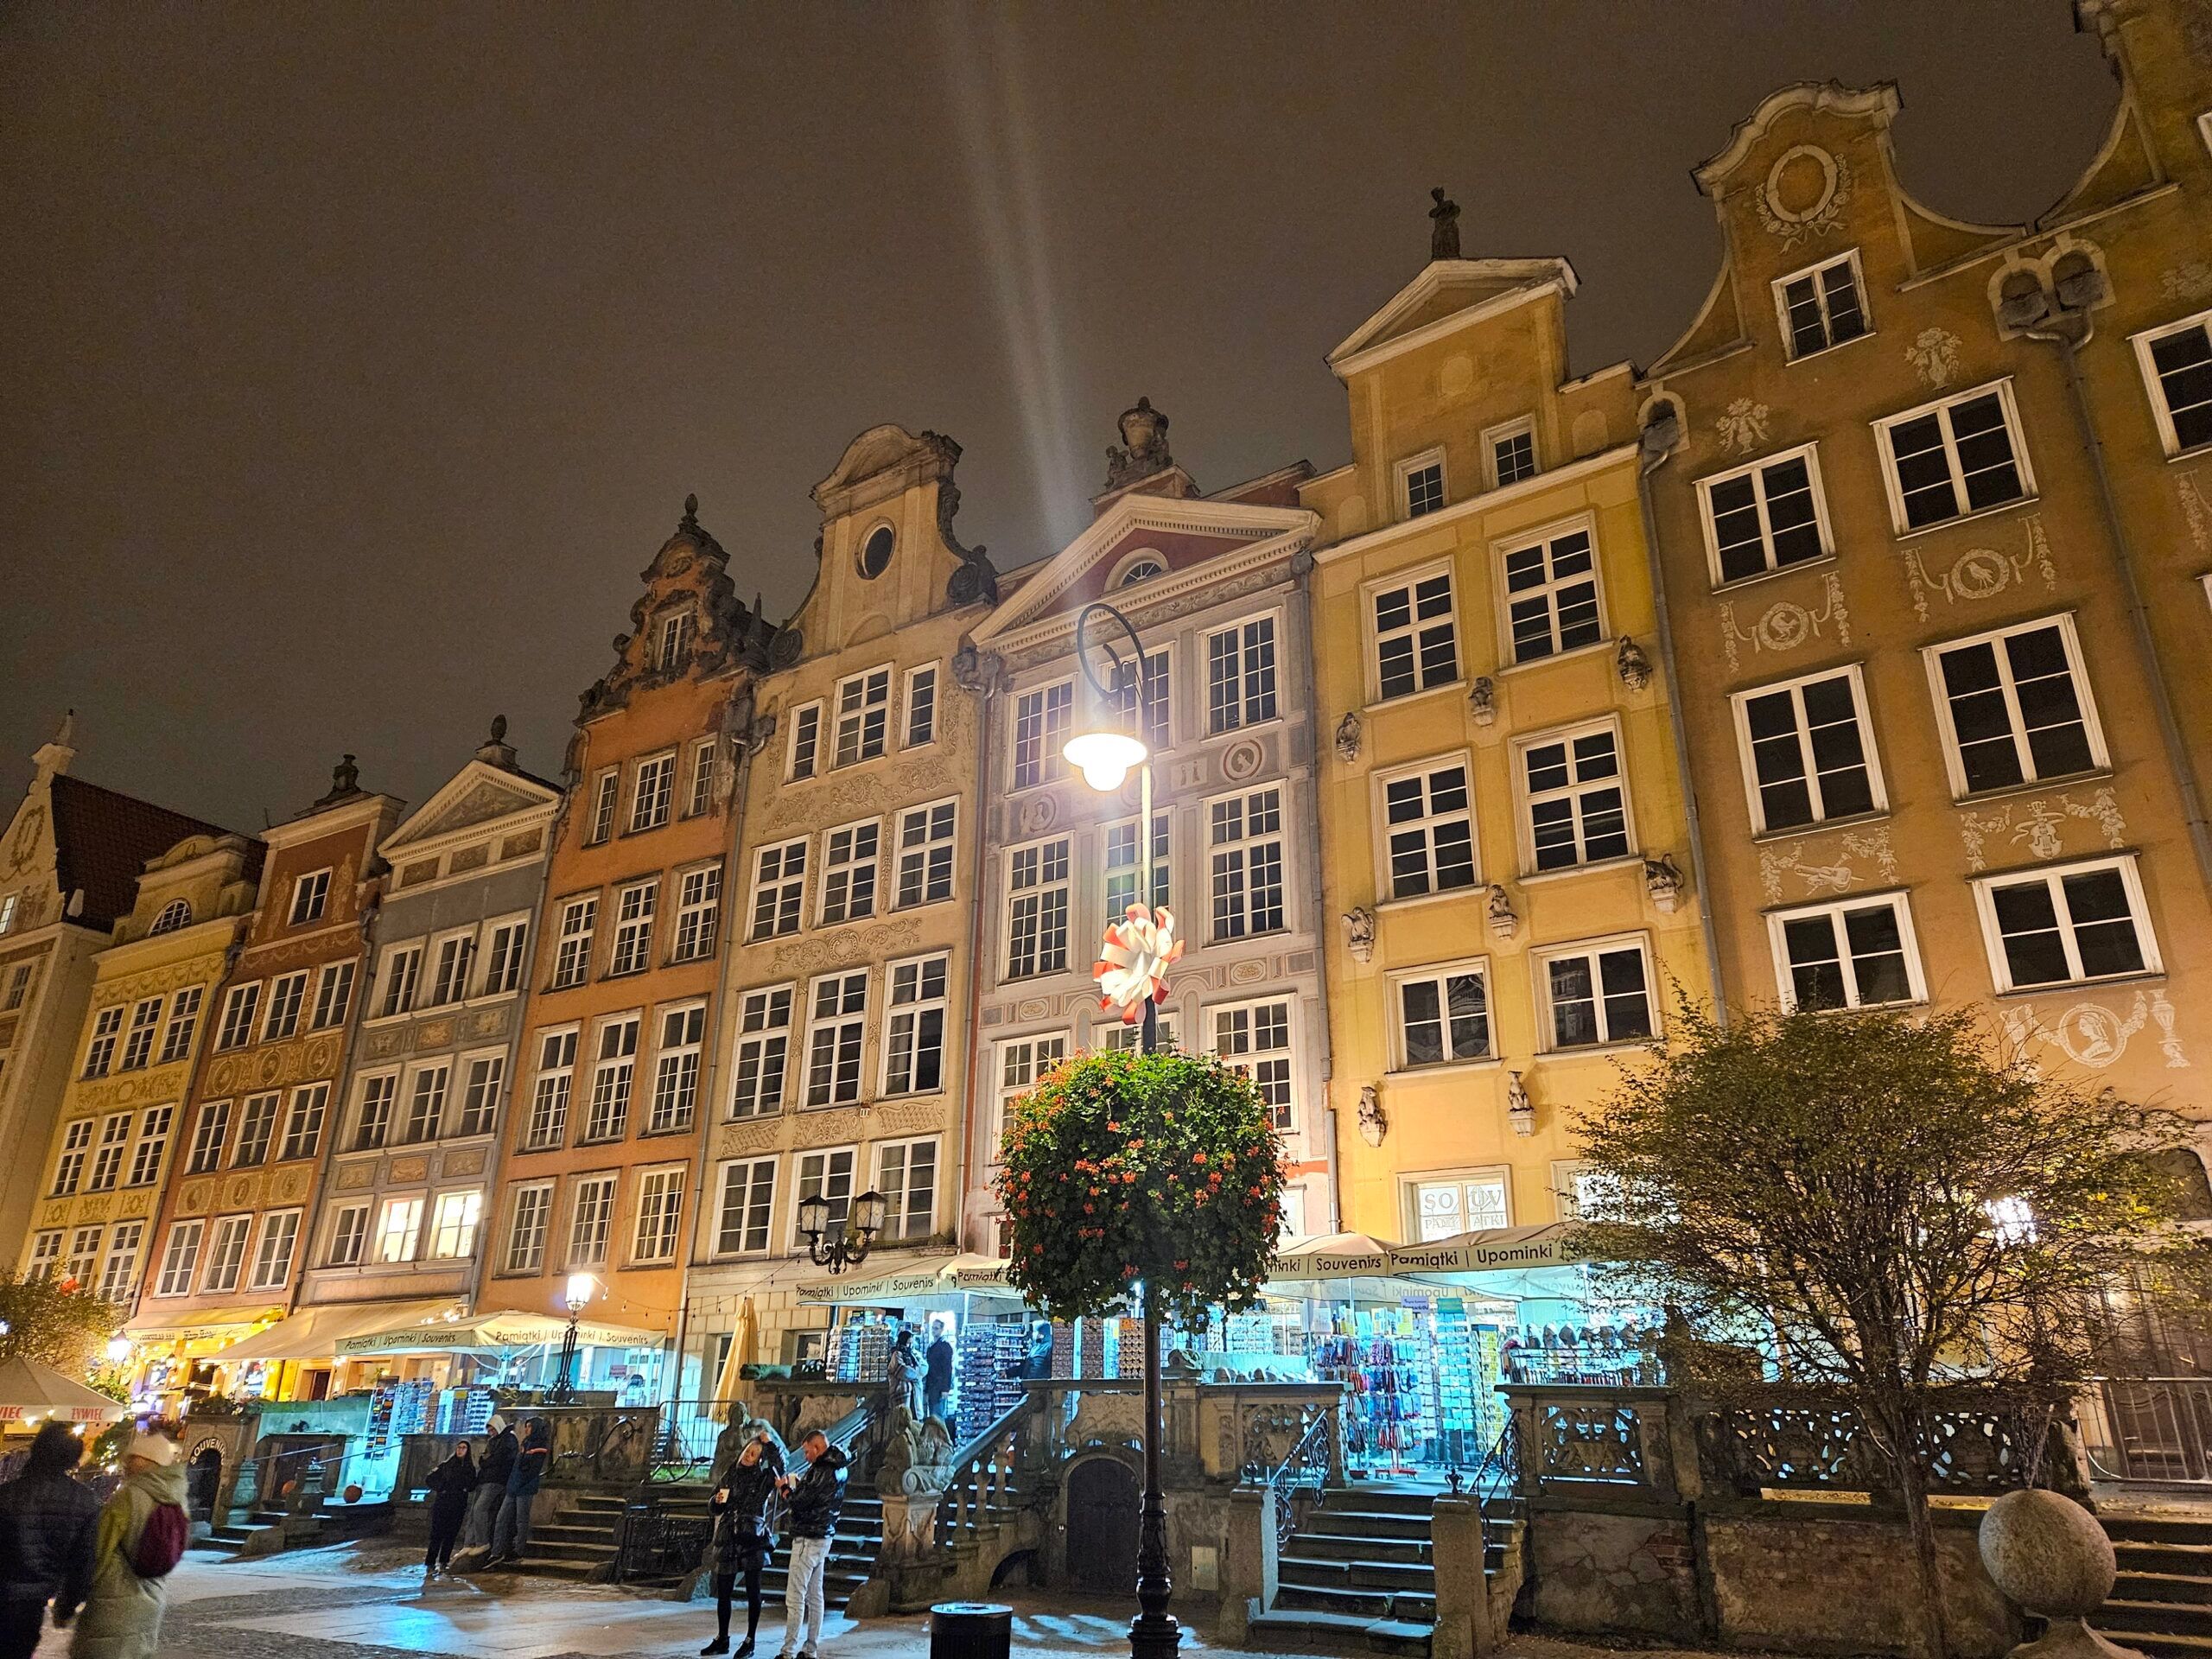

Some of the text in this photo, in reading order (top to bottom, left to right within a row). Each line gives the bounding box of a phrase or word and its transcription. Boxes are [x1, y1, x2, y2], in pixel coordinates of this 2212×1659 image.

[1265, 1255, 1382, 1272] minki Souvenirs
[1390, 1243, 1553, 1268] Pamiątki Upominki
[796, 1276, 934, 1300] Pamiątki Upominki Souvenirs
[383, 1332, 416, 1347] Upominki
[421, 1332, 456, 1344] Souvenirs
[551, 1329, 596, 1341] Upinki
[606, 1332, 648, 1345] Souvenirs
